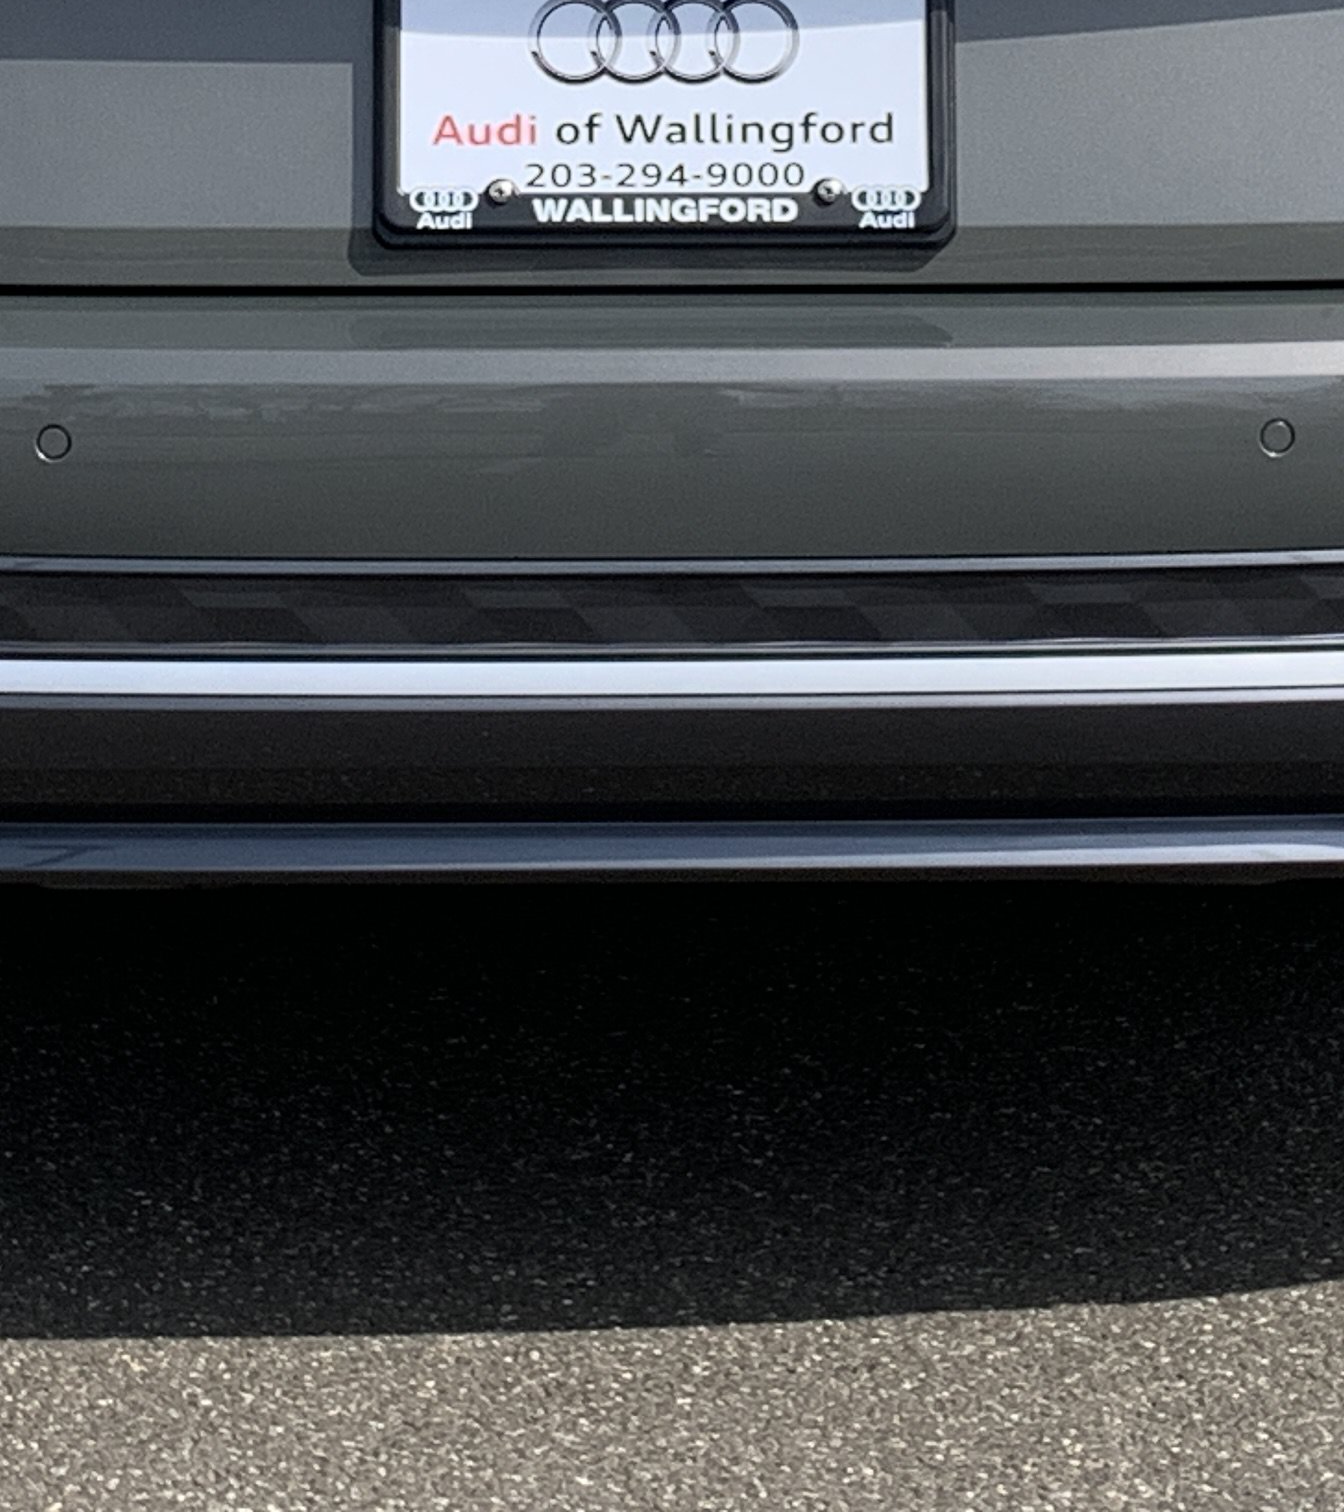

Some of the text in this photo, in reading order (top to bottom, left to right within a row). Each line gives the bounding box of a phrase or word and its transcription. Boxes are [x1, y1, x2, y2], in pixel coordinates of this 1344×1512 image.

[432, 112, 894, 152] Audi of Wallingford
[524, 162, 806, 188] 203-294-9000
[416, 211, 474, 230] Audi
[533, 197, 798, 224] WALLINGFORD
[859, 210, 916, 229] Audi
